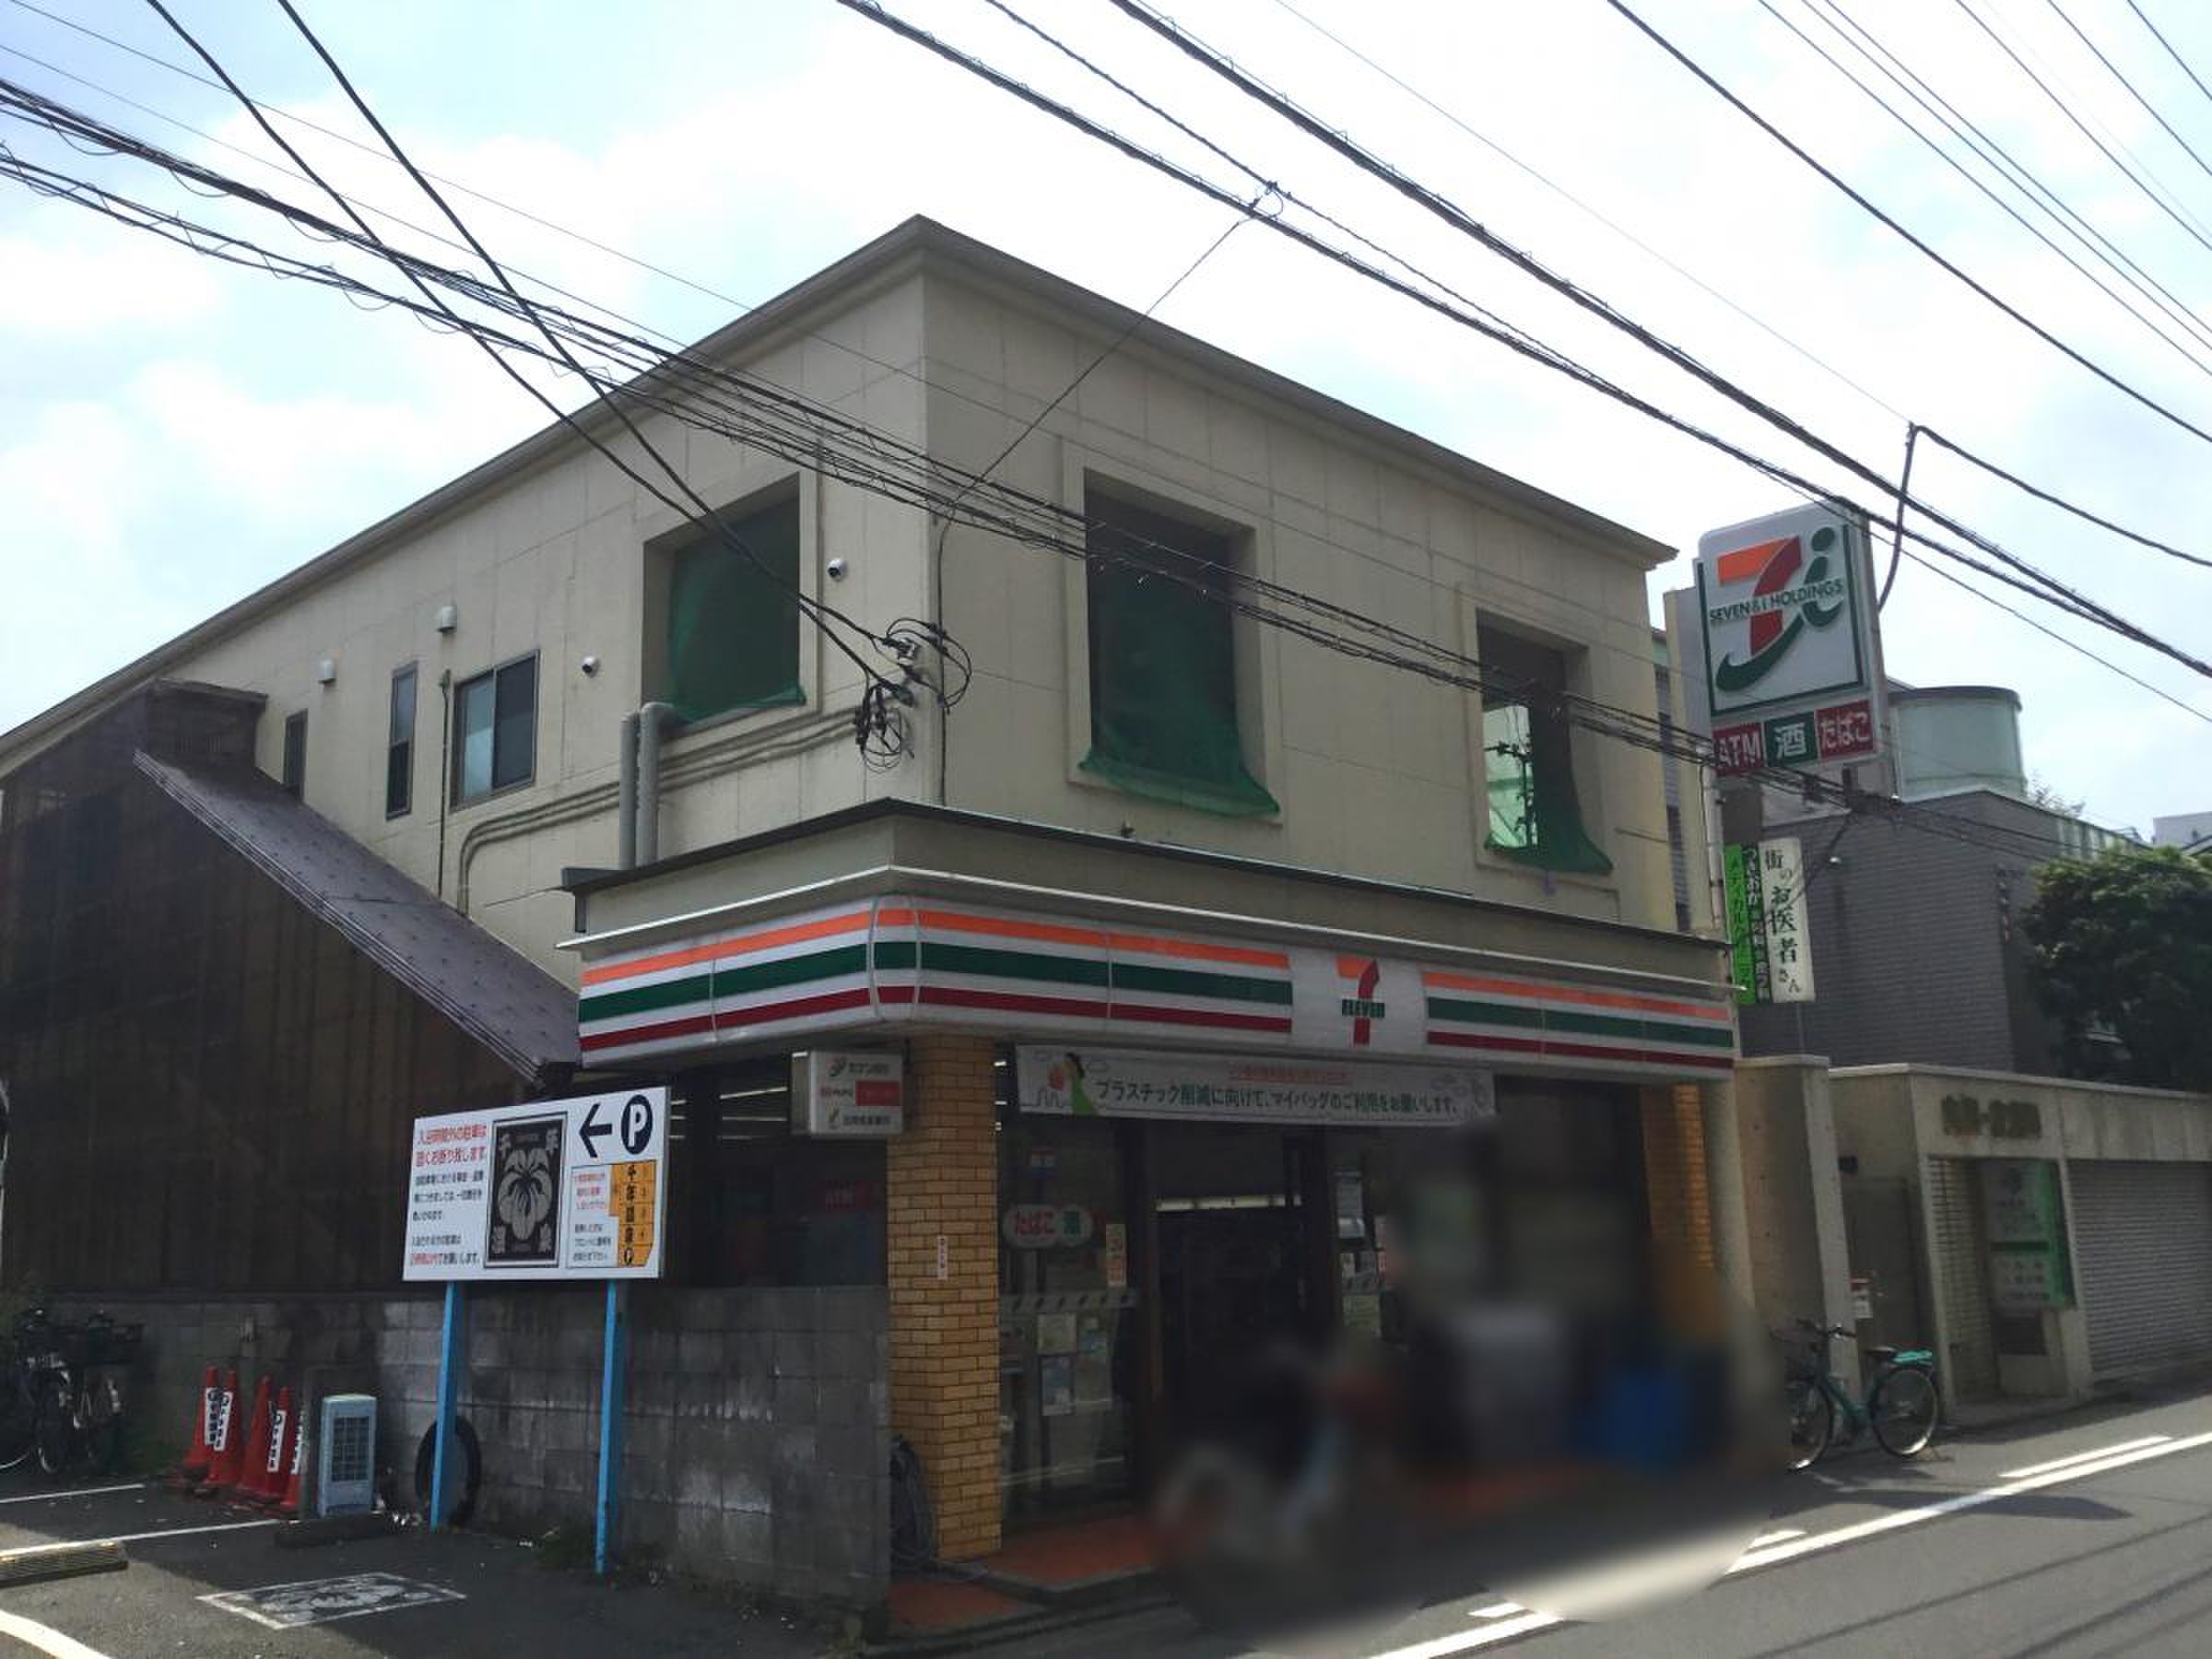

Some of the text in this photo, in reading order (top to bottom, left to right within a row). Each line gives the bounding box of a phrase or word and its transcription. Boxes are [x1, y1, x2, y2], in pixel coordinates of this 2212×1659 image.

[1718, 731, 1762, 767] ATM
[1774, 722, 1806, 760] 酒
[1820, 712, 1870, 749] たばこ
